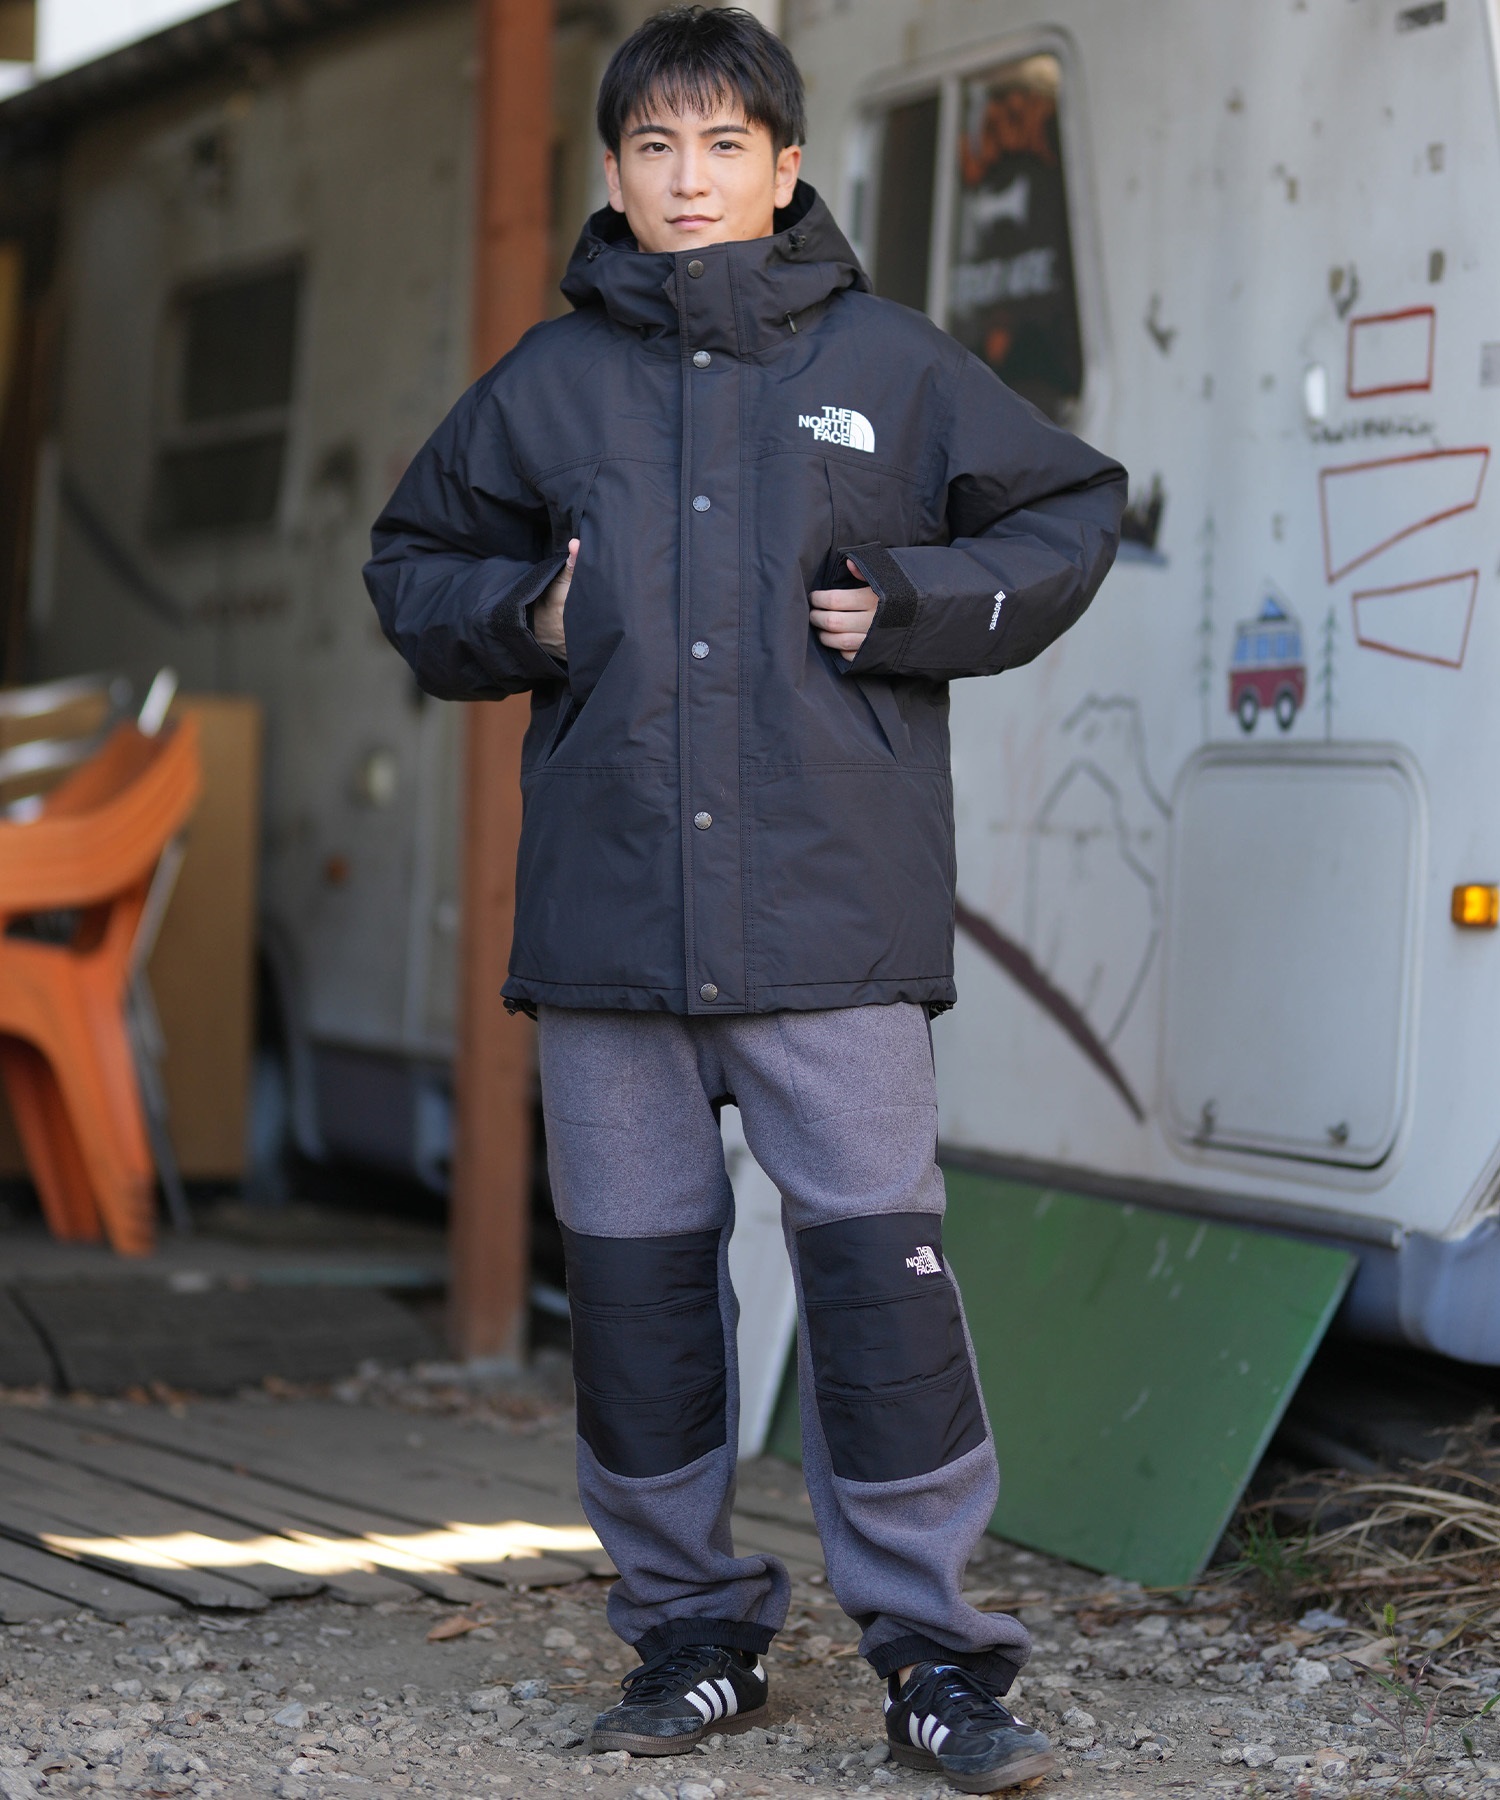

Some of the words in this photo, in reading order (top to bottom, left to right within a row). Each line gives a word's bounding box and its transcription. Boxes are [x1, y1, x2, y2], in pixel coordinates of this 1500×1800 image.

[821, 405, 851, 421] THE
[798, 414, 850, 434] NORTH
[813, 427, 850, 447] FACE
[905, 1256, 930, 1268] NORTH
[916, 1264, 934, 1275] FACE
